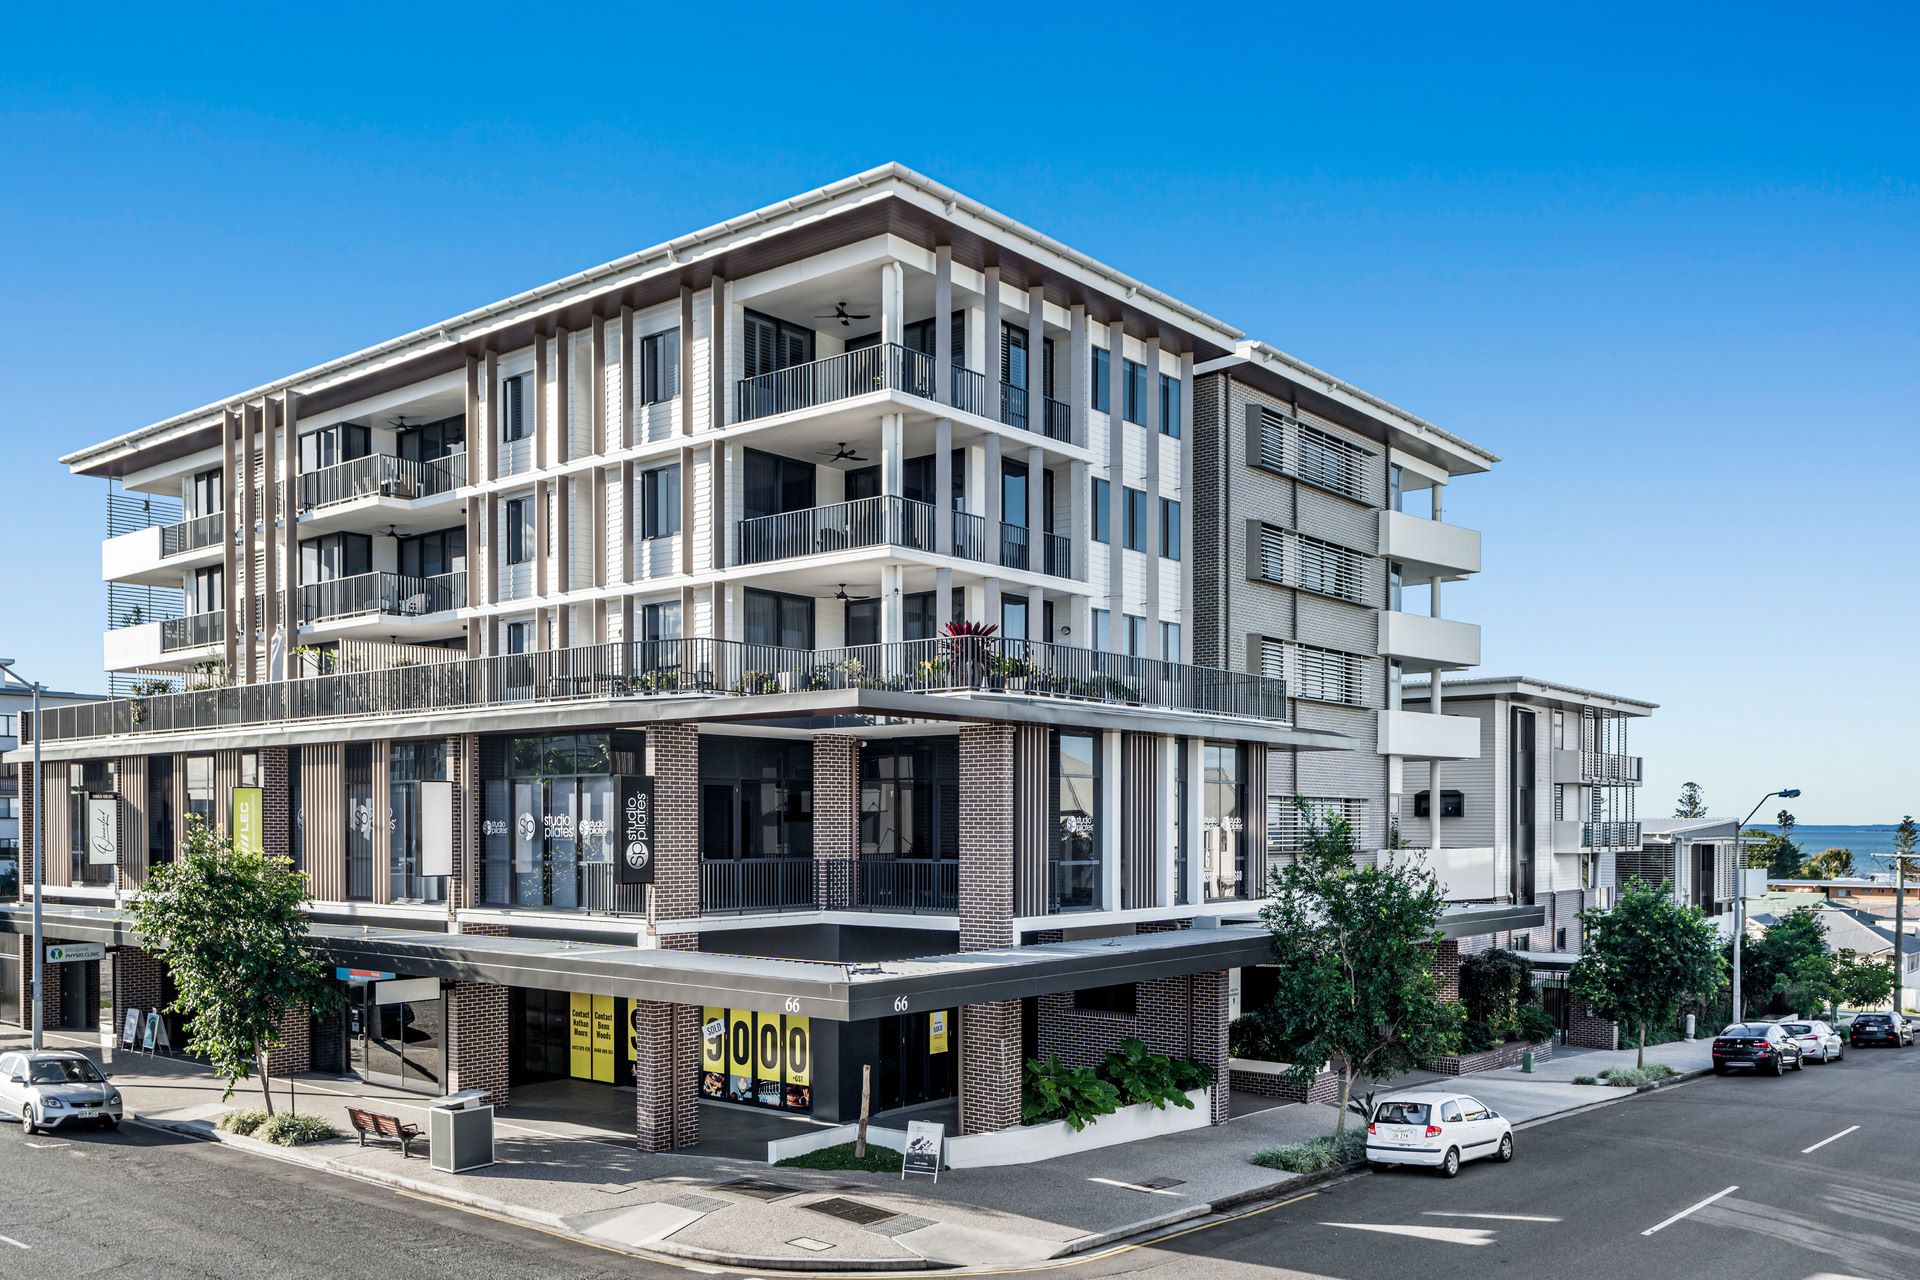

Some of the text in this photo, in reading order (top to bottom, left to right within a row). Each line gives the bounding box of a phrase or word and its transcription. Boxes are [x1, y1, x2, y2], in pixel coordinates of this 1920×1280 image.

[544, 813, 570, 826] studio
[625, 797, 637, 841] studio
[635, 793, 649, 841] pilates
[544, 825, 574, 840] pilates
[785, 997, 800, 1013] 66
[894, 996, 908, 1012] 66
[572, 1009, 590, 1019] Contact
[595, 1012, 613, 1021] Contact
[596, 1031, 611, 1040] Woods
[706, 1023, 722, 1036] SOLD
